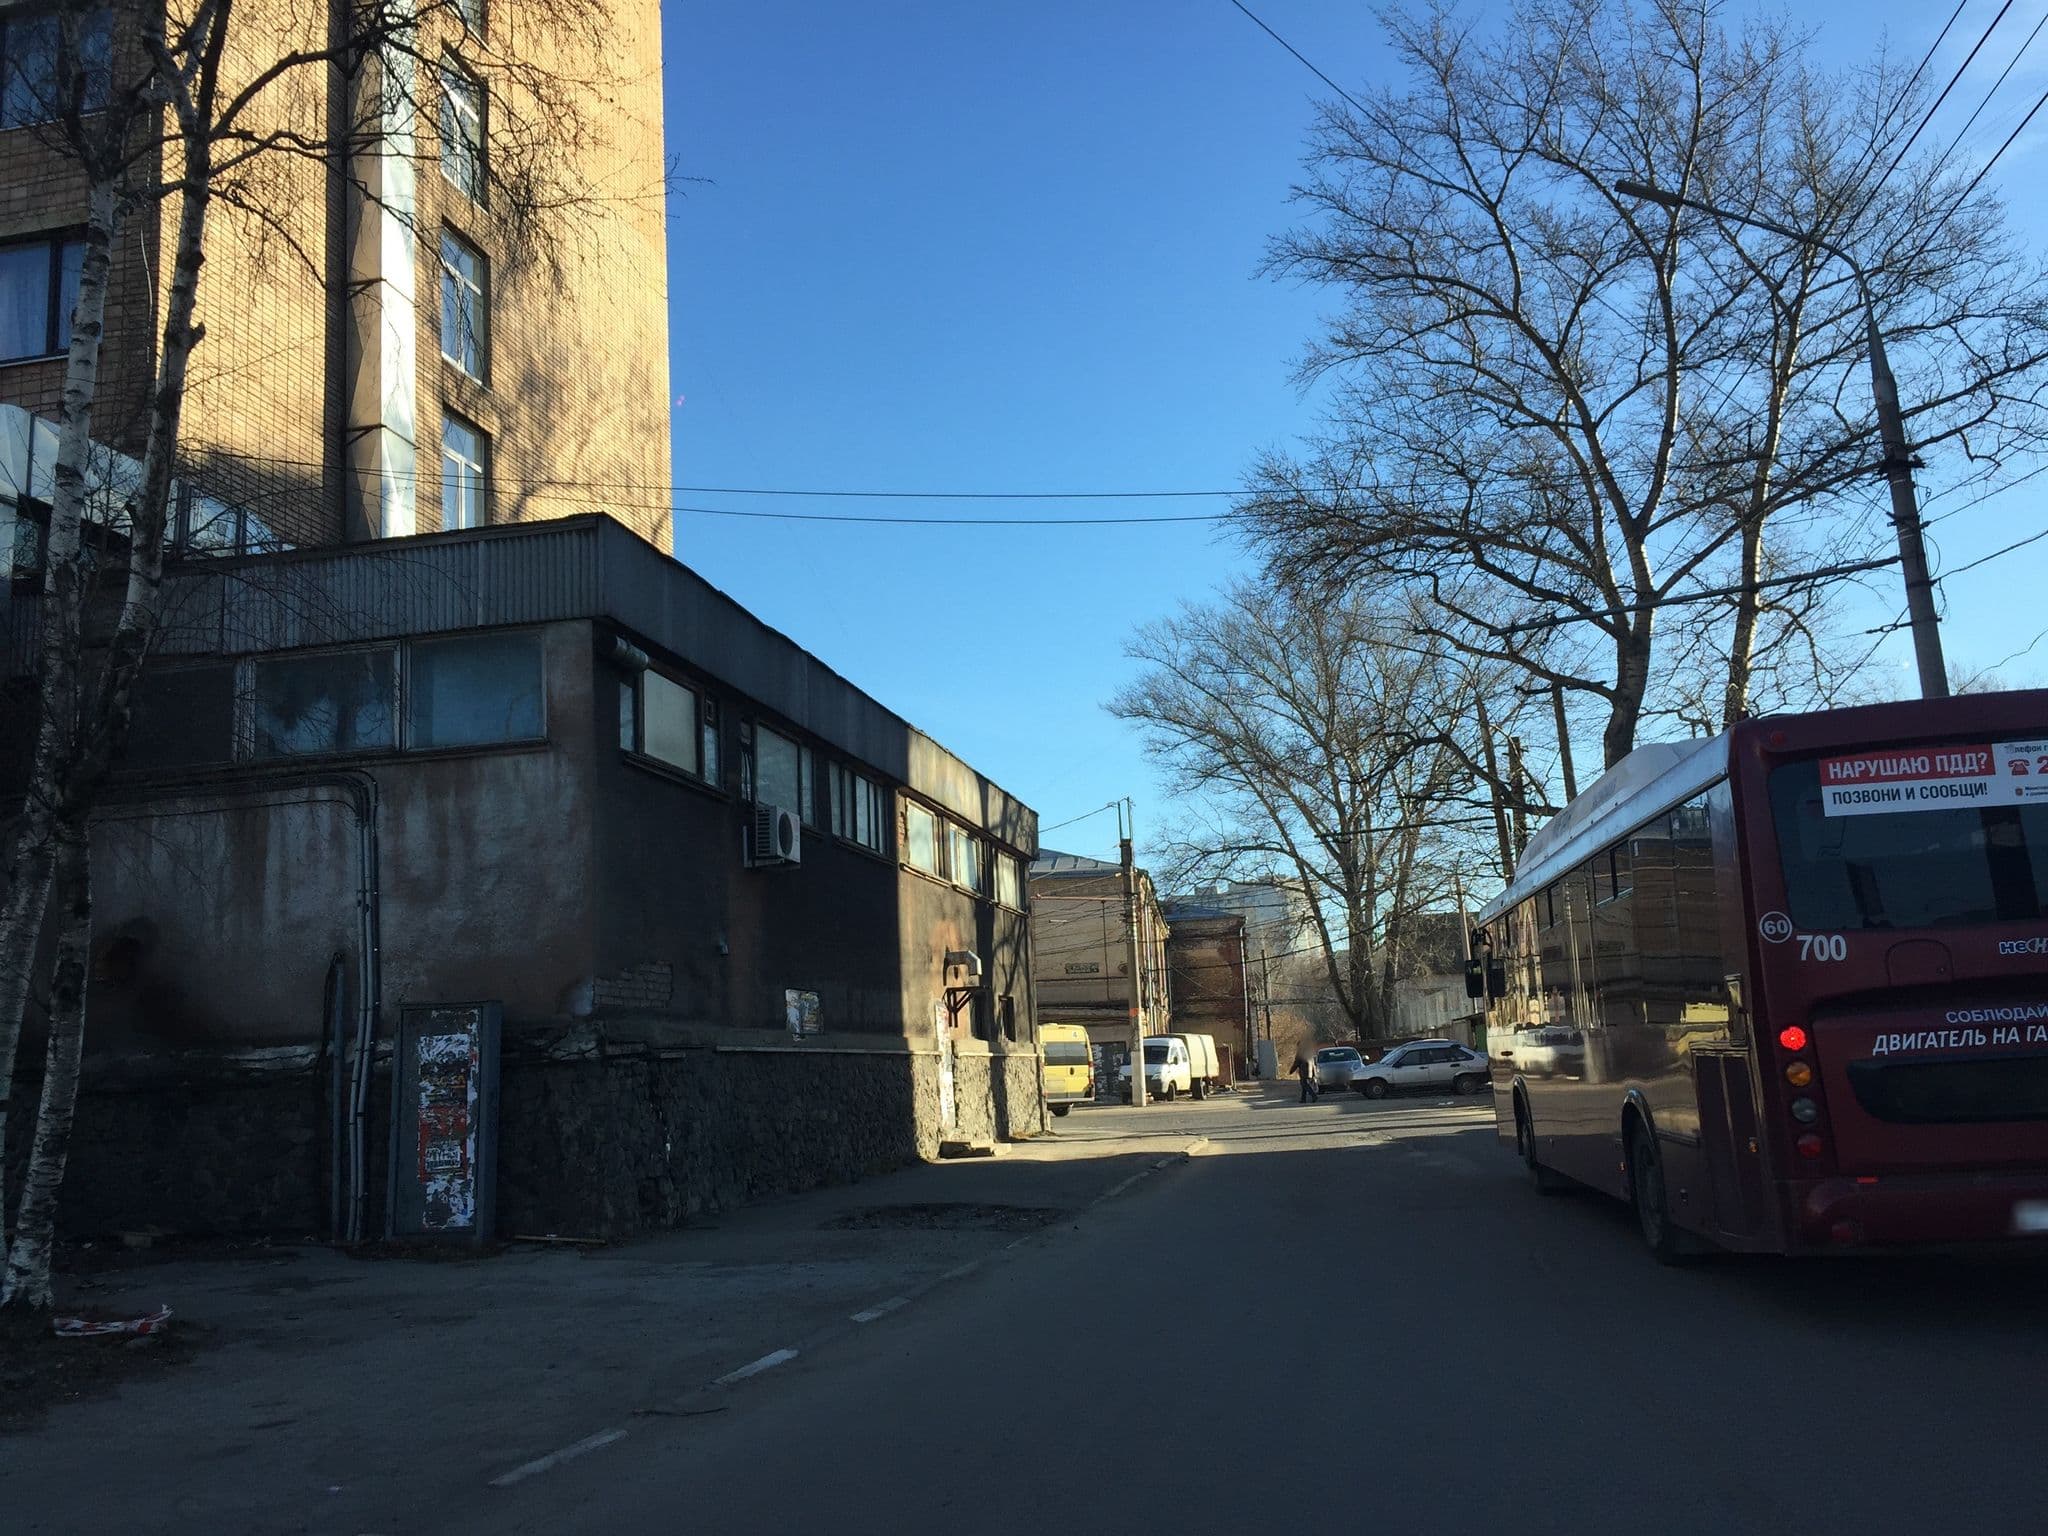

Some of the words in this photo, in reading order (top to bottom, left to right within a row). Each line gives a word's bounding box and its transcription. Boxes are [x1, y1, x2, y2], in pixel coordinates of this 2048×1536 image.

[1829, 755, 1930, 779] НАРУШАЮ
[1935, 752, 1988, 776] ПДД?
[1832, 788, 1902, 806] ПОЗВОНИ
[1905, 787, 1916, 801] И
[1919, 782, 1989, 800] СООБЩИ!
[1763, 920, 1788, 935] 60
[1796, 934, 1848, 961] 700
[1873, 1028, 1987, 1056] ДВИГАТЕЛЬ
[1992, 1026, 2021, 1045] НА
